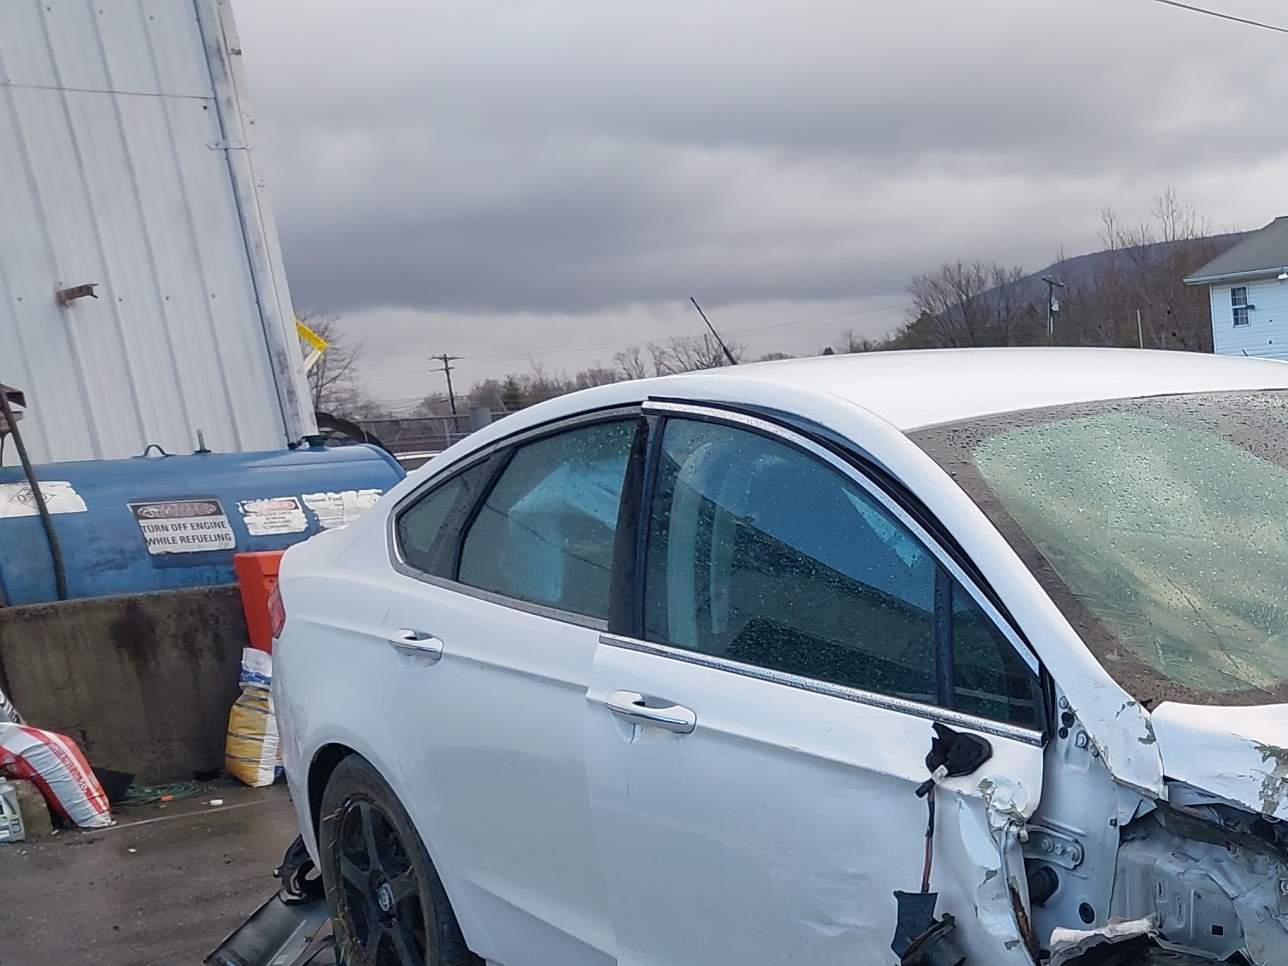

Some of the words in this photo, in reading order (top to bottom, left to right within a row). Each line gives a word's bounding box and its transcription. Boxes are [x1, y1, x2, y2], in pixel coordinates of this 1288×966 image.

[143, 524, 169, 534] TURN
[171, 523, 189, 532] OFF
[191, 521, 227, 531] ENGINE
[146, 536, 178, 546] WHILE
[180, 533, 232, 544] REFUELING
